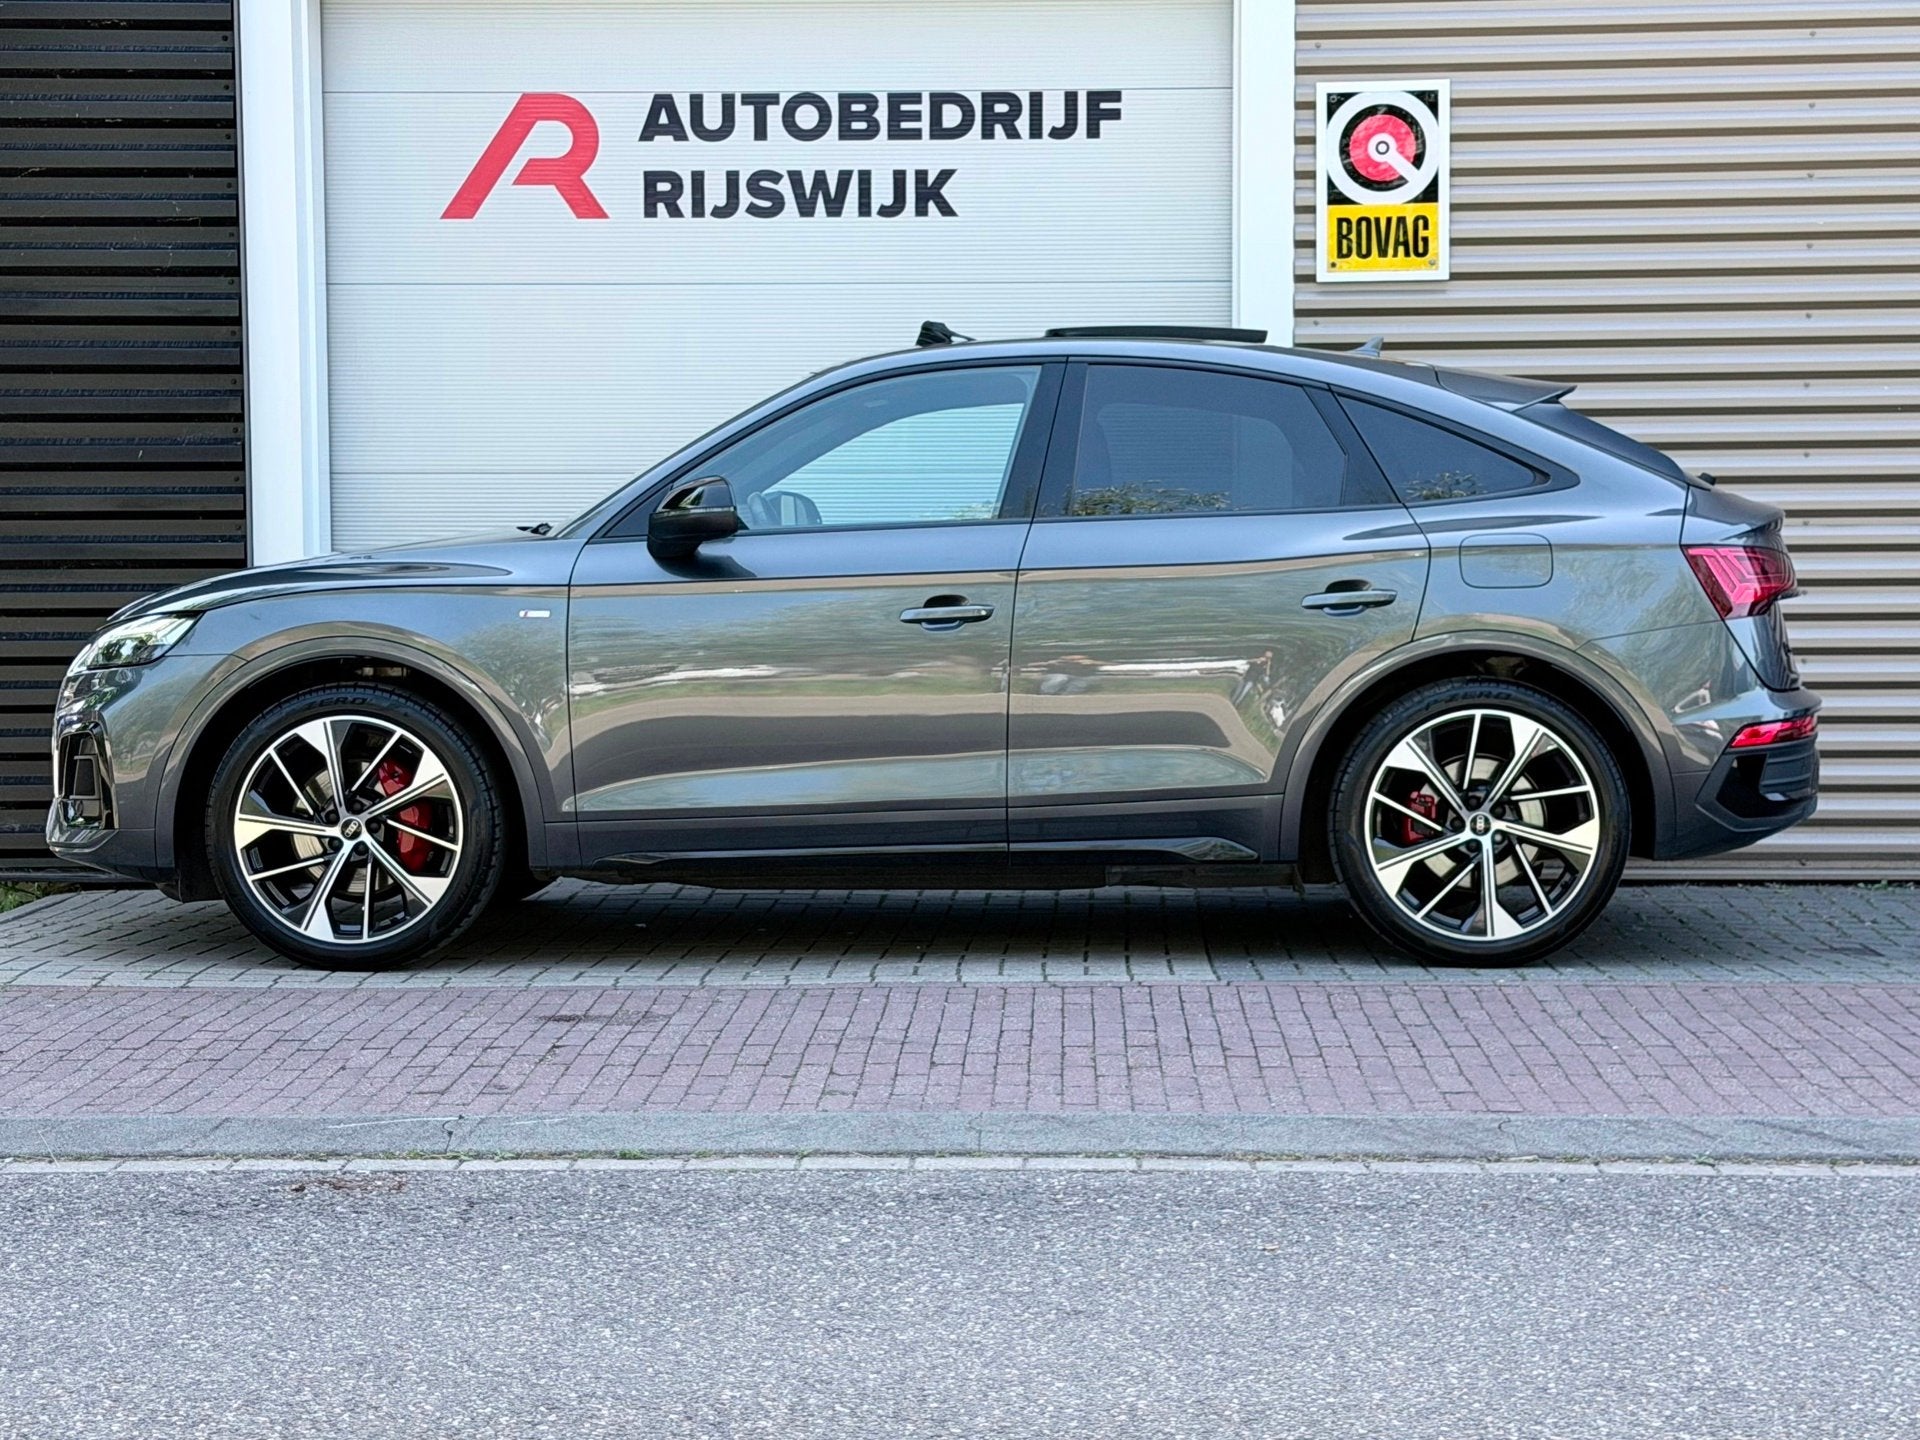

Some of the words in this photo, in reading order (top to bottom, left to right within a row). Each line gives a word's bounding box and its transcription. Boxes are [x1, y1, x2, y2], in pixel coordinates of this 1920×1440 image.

[639, 90, 1122, 142] AUTOBEDRIJF
[643, 168, 958, 219] RIJSWIJK
[1336, 214, 1430, 259] BOVAG
